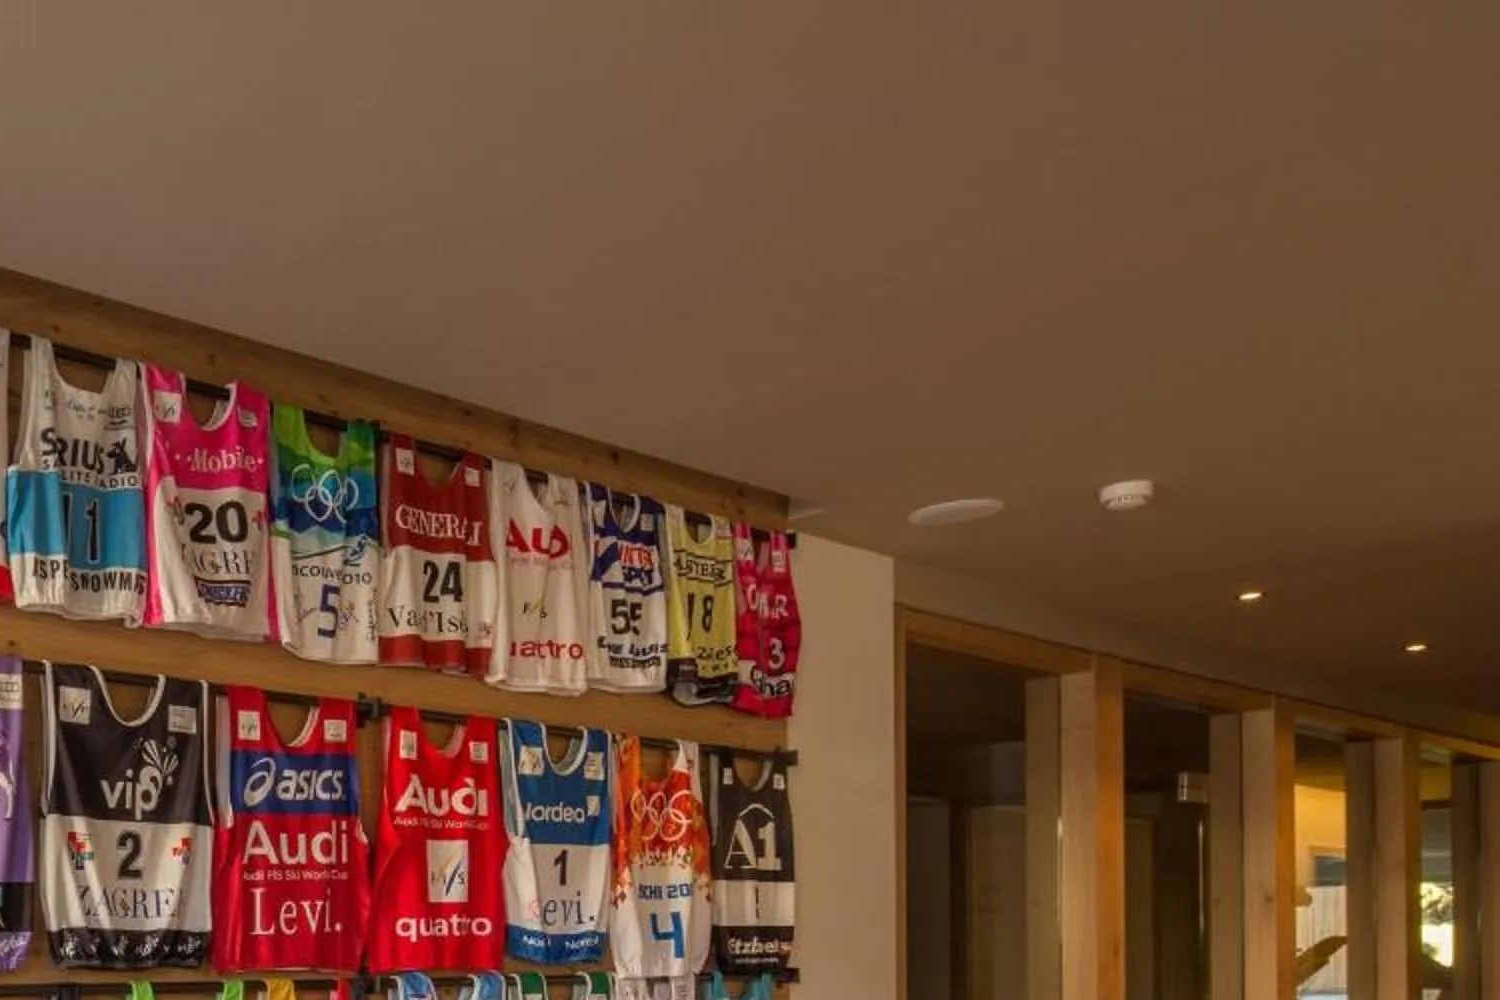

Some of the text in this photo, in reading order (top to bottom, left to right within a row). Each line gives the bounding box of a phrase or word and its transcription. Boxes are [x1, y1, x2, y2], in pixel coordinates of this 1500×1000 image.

[184, 501, 249, 544] 20
[423, 559, 463, 603] 24
[317, 583, 342, 639] 5
[101, 766, 163, 821] vip
[276, 769, 345, 801] asics
[395, 773, 488, 817] Audi
[116, 830, 142, 881] 2
[242, 820, 348, 866] Audi
[552, 850, 568, 887] 1
[651, 911, 686, 960] 4
